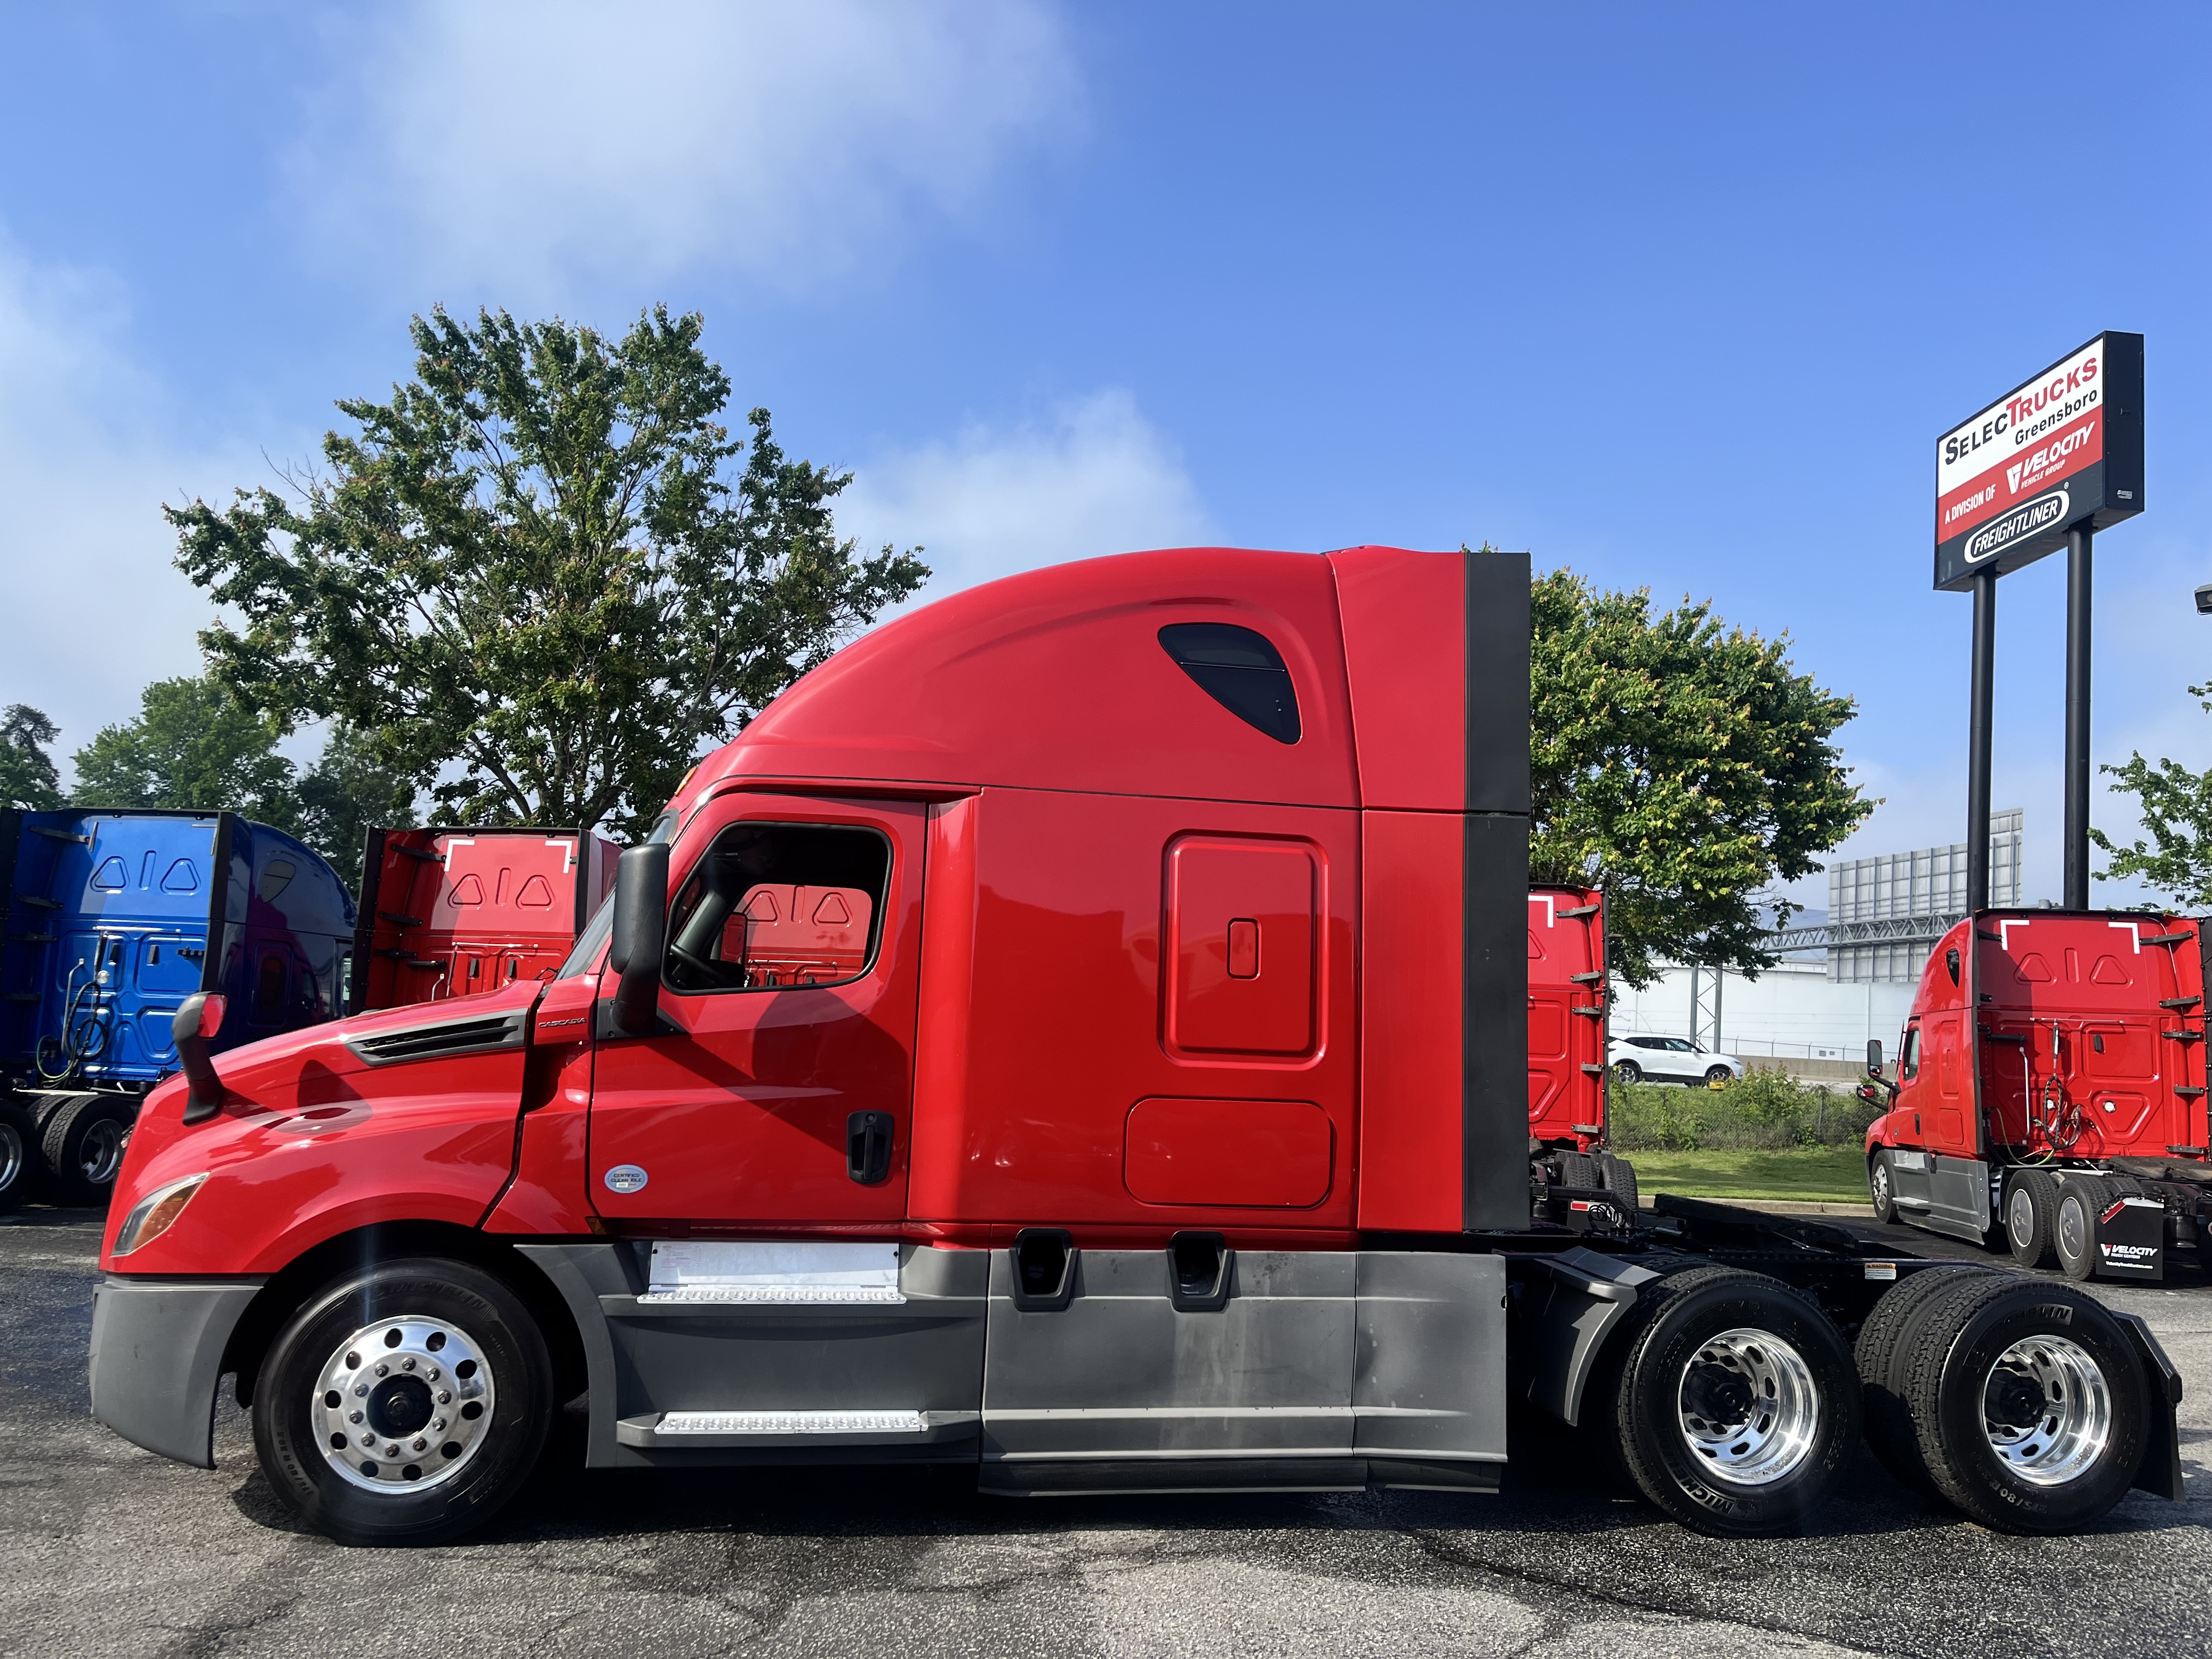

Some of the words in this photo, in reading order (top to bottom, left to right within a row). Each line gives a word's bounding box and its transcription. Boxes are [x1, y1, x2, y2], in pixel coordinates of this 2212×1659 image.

[2015, 390, 2097, 445] Greensboro
[2023, 421, 2096, 477] VELOCITY
[2021, 470, 2044, 489] VEHICLE
[2045, 459, 2066, 477] GROUP
[1945, 509, 1951, 524] A
[1951, 490, 1984, 521] DIVISION
[1985, 484, 1996, 503] OF
[1973, 499, 2058, 555] FREIGHTLINER
[2112, 1244, 2158, 1256] VELOCITY
